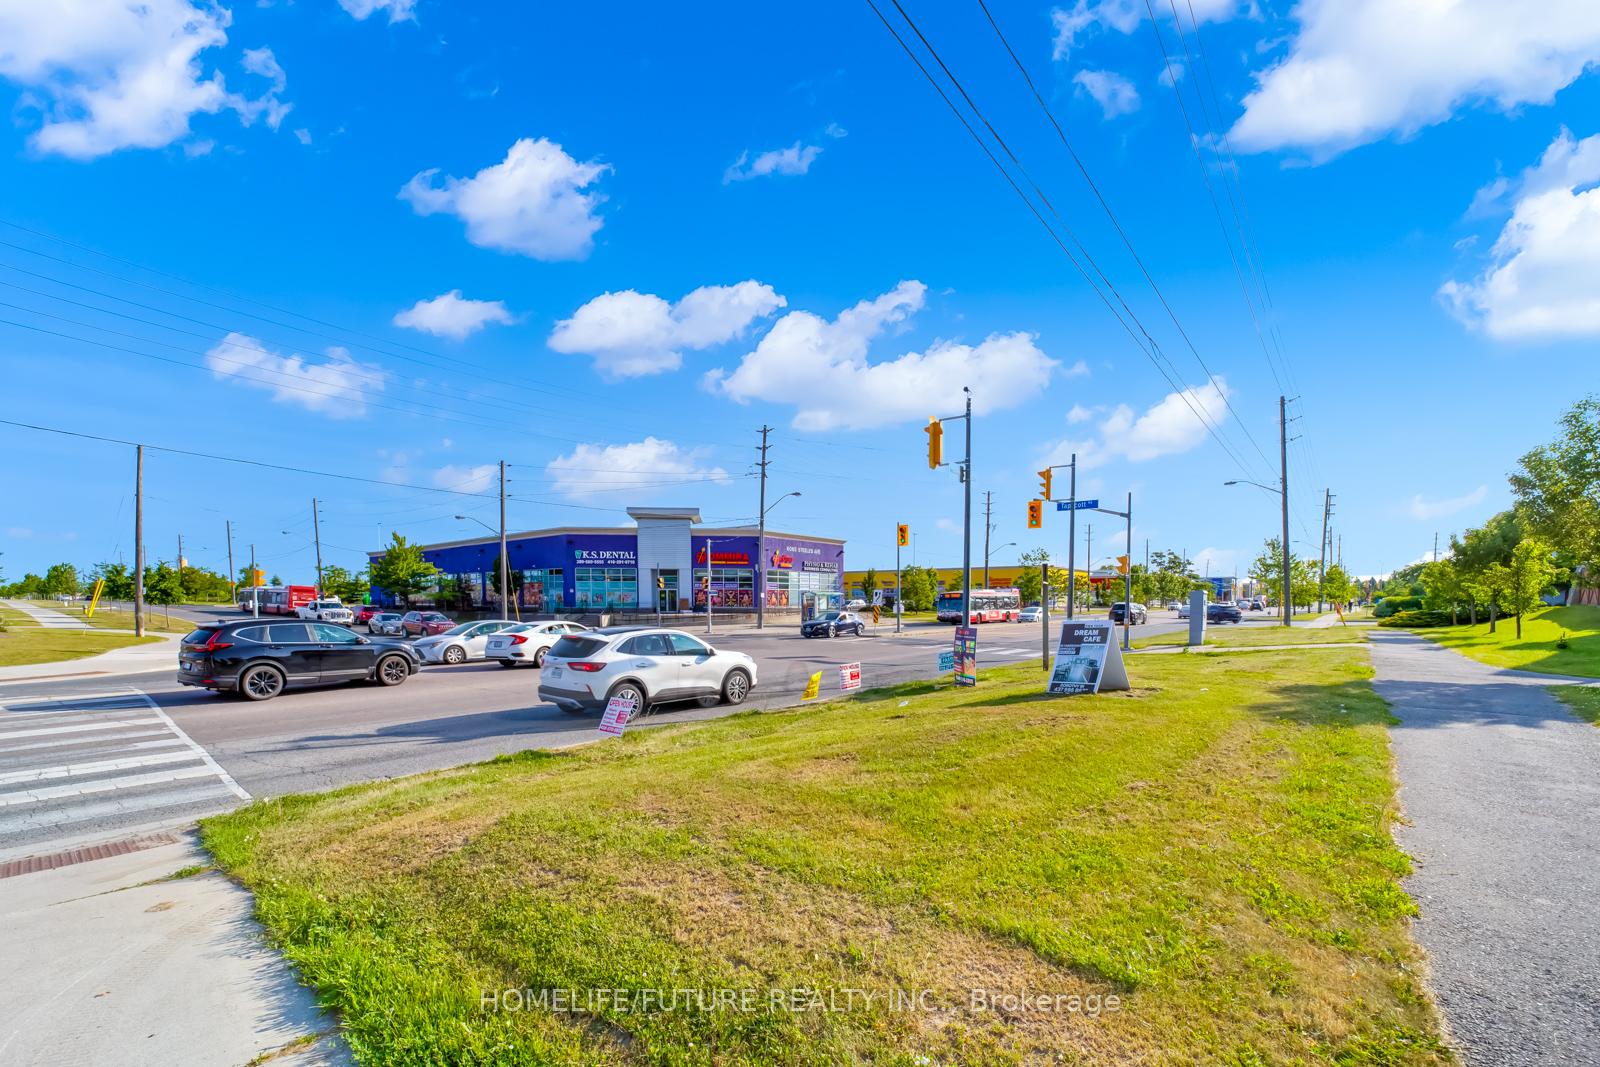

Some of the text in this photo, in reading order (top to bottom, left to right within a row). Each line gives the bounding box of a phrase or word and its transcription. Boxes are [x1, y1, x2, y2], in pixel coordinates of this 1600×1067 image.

[582, 551, 636, 559] K.S. DENTAL
[609, 699, 620, 707] OPEN
